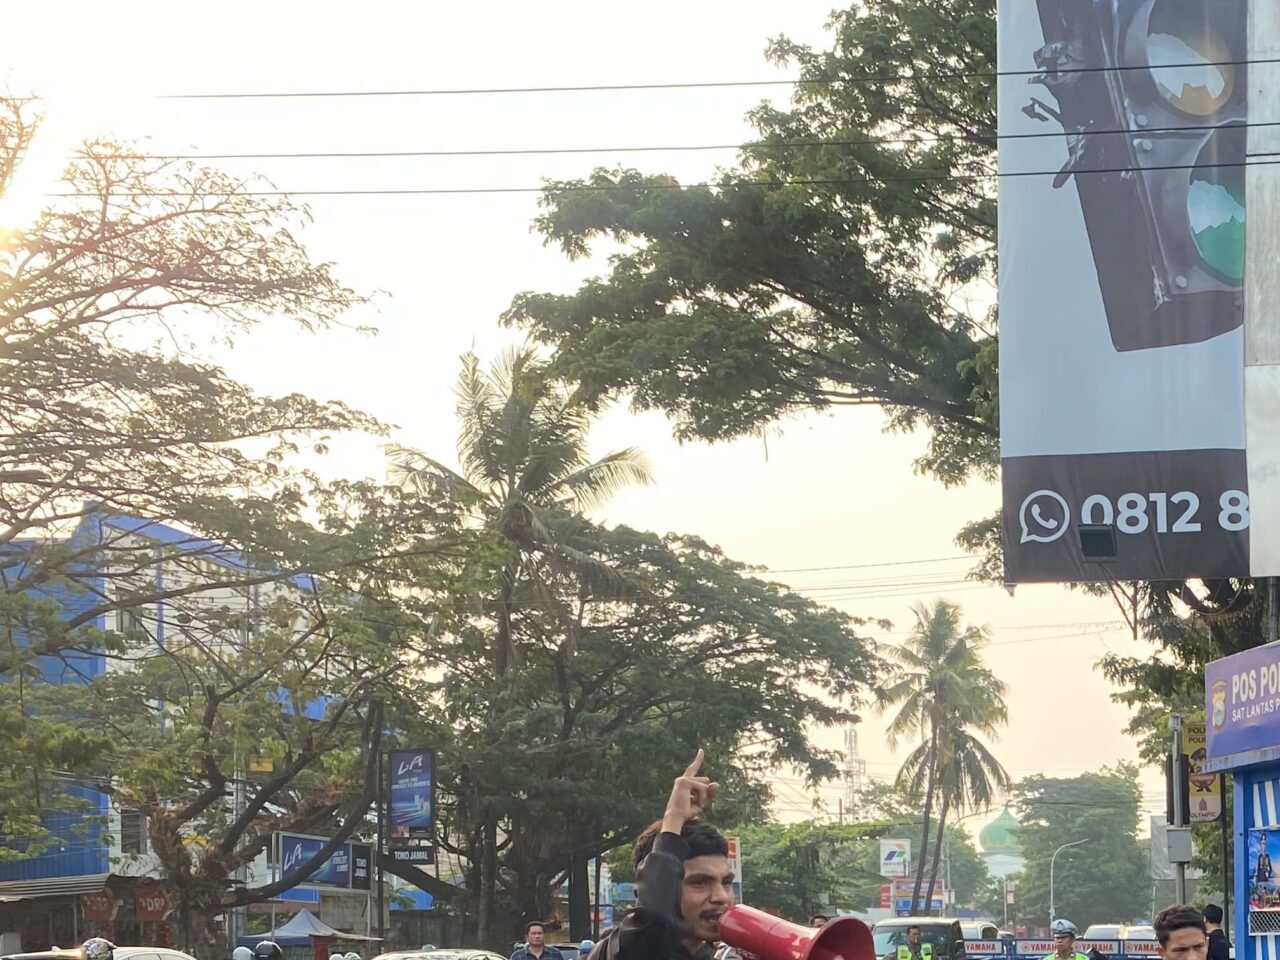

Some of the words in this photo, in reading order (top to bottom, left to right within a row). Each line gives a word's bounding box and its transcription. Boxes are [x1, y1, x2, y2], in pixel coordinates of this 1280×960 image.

[1081, 490, 1202, 534] 0812
[1232, 671, 1257, 705] POS
[1232, 709, 1246, 722] SAT
[1246, 698, 1275, 718] LANTAS
[394, 851, 409, 860] TOKO
[410, 851, 429, 860] JAMAL
[966, 943, 996, 951] YAMAHA
[1031, 943, 1056, 952] YAMAH
